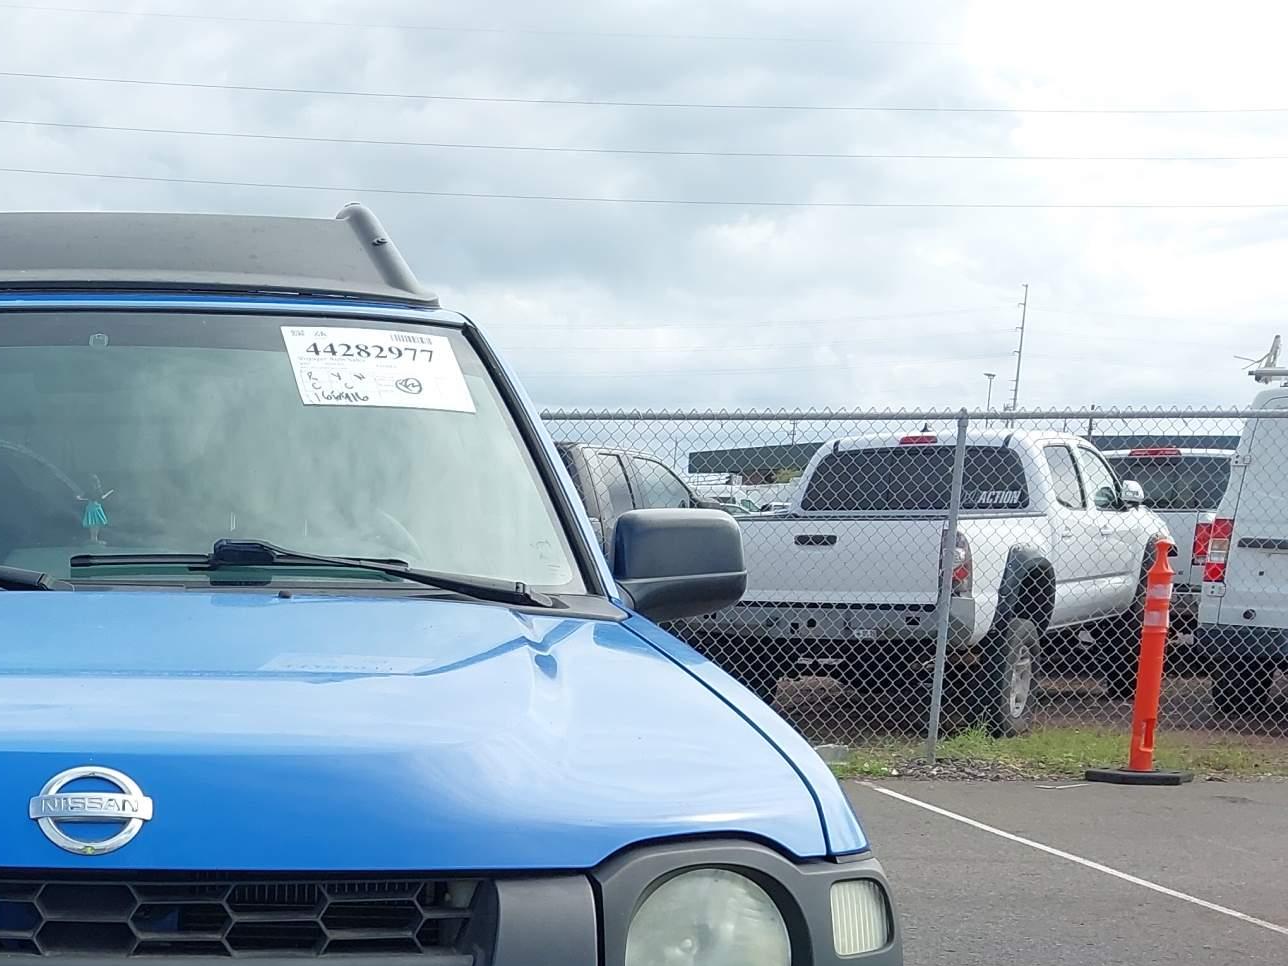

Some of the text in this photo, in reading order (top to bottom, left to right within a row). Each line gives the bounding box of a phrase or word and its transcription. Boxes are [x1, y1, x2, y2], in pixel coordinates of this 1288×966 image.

[305, 342, 433, 363] 44282977
[977, 490, 1021, 504] ACTION
[41, 797, 139, 813] NISSAN
